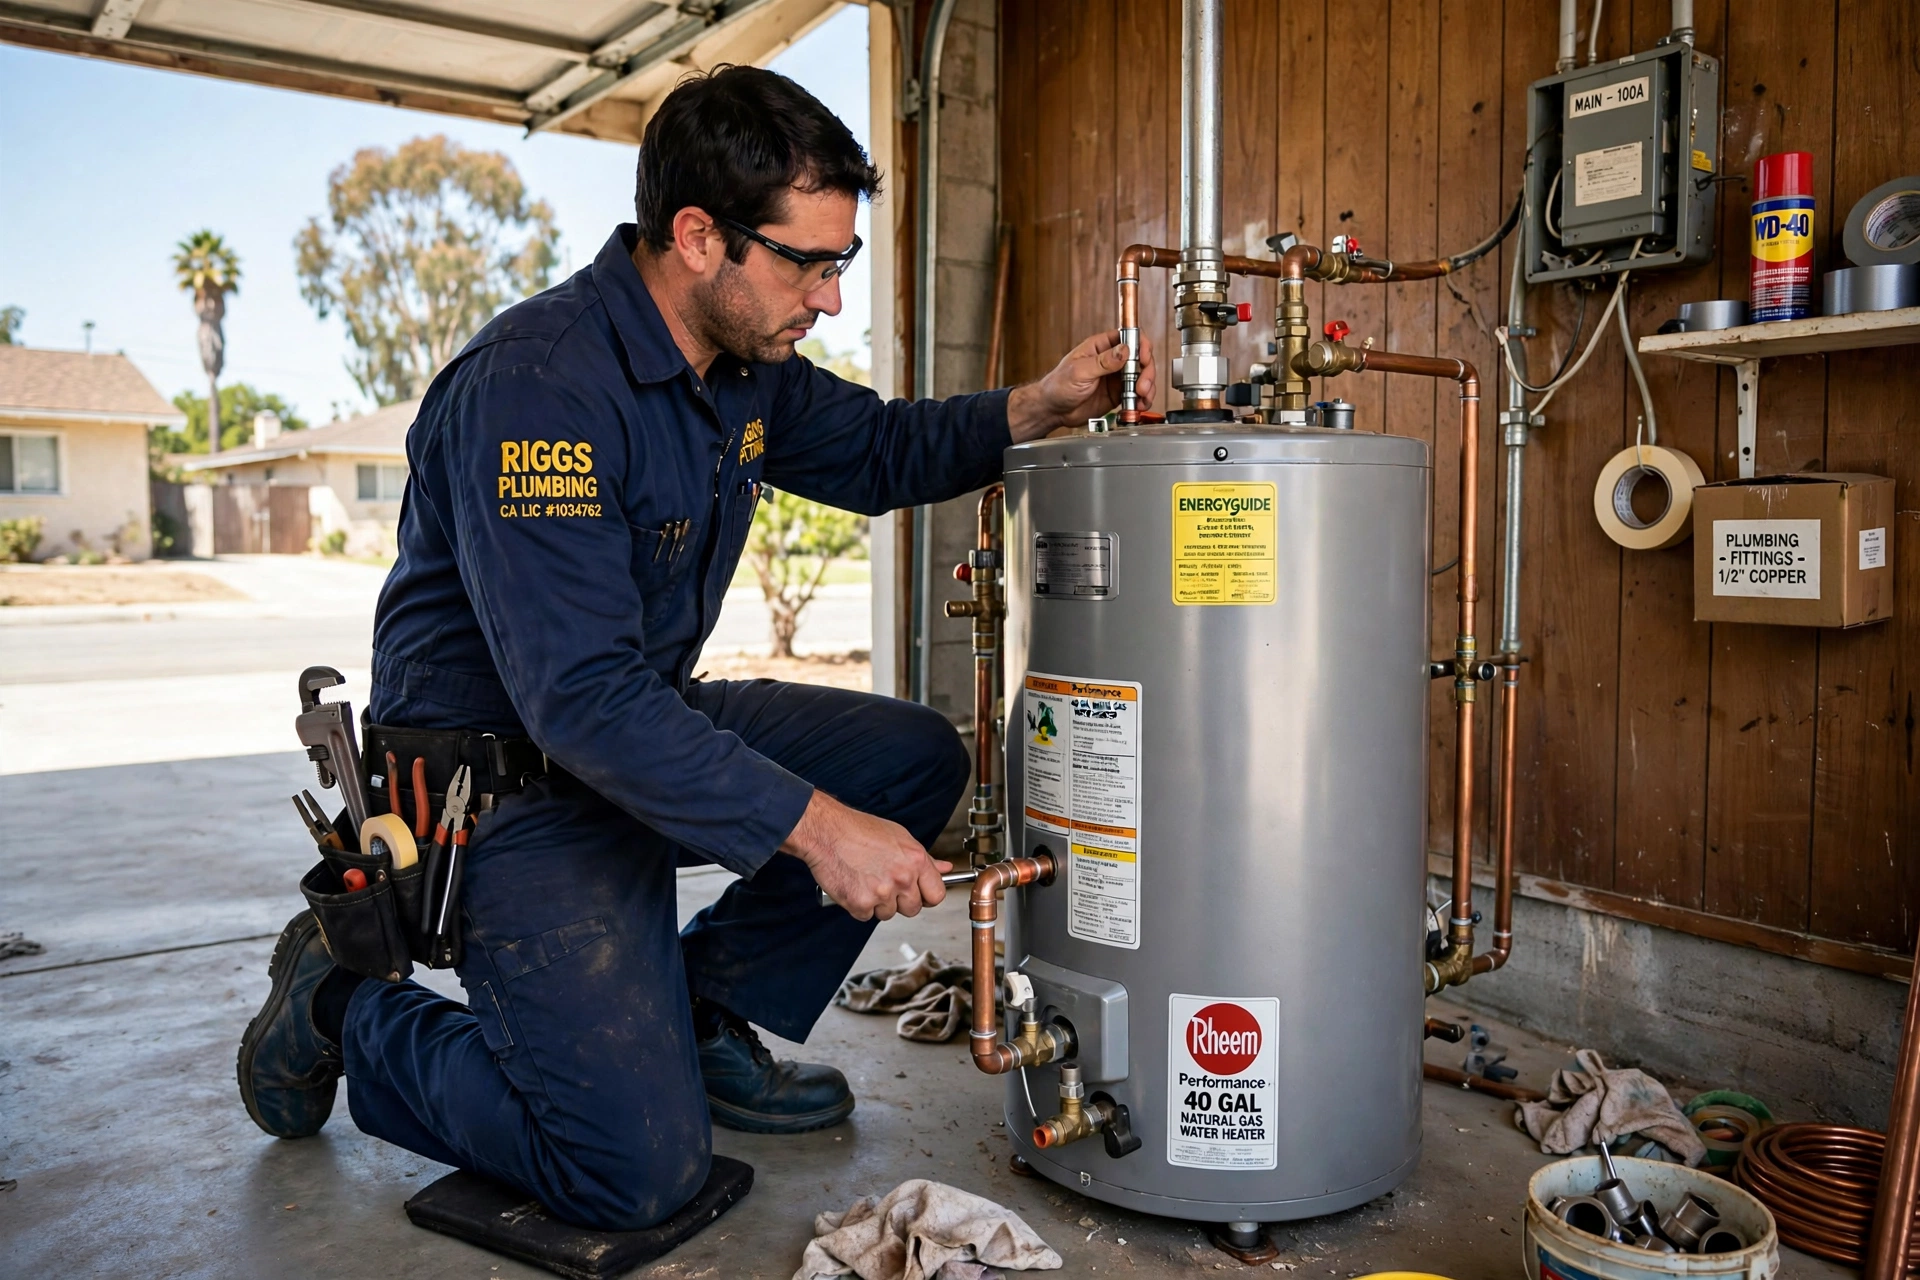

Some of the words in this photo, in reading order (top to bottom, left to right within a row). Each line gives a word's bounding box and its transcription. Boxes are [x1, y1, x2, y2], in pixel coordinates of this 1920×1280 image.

[1575, 93, 1602, 112] MAIN
[1617, 83, 1644, 102] 100A
[1754, 213, 1809, 241] WD-40
[501, 440, 593, 474] RIGGS
[498, 475, 598, 499] PLUMBING
[500, 504, 518, 518] CA
[521, 503, 541, 518] LIC
[545, 503, 602, 518] #1034762
[1179, 498, 1271, 516] ENERGYGUIDE
[1726, 533, 1800, 548] PLUMBING
[1730, 550, 1794, 566] FITTINGS
[1718, 568, 1745, 586] 1/2"
[1749, 569, 1807, 584] COPPER
[1191, 1016, 1258, 1055] Rheem
[1179, 1072, 1266, 1089] Performance
[1184, 1090, 1212, 1111] 40
[1217, 1092, 1262, 1113] GAL
[1181, 1111, 1236, 1127] NATURAL
[1239, 1114, 1263, 1127] GAS
[1180, 1124, 1218, 1139] WATER
[1222, 1127, 1266, 1140] HEATER
